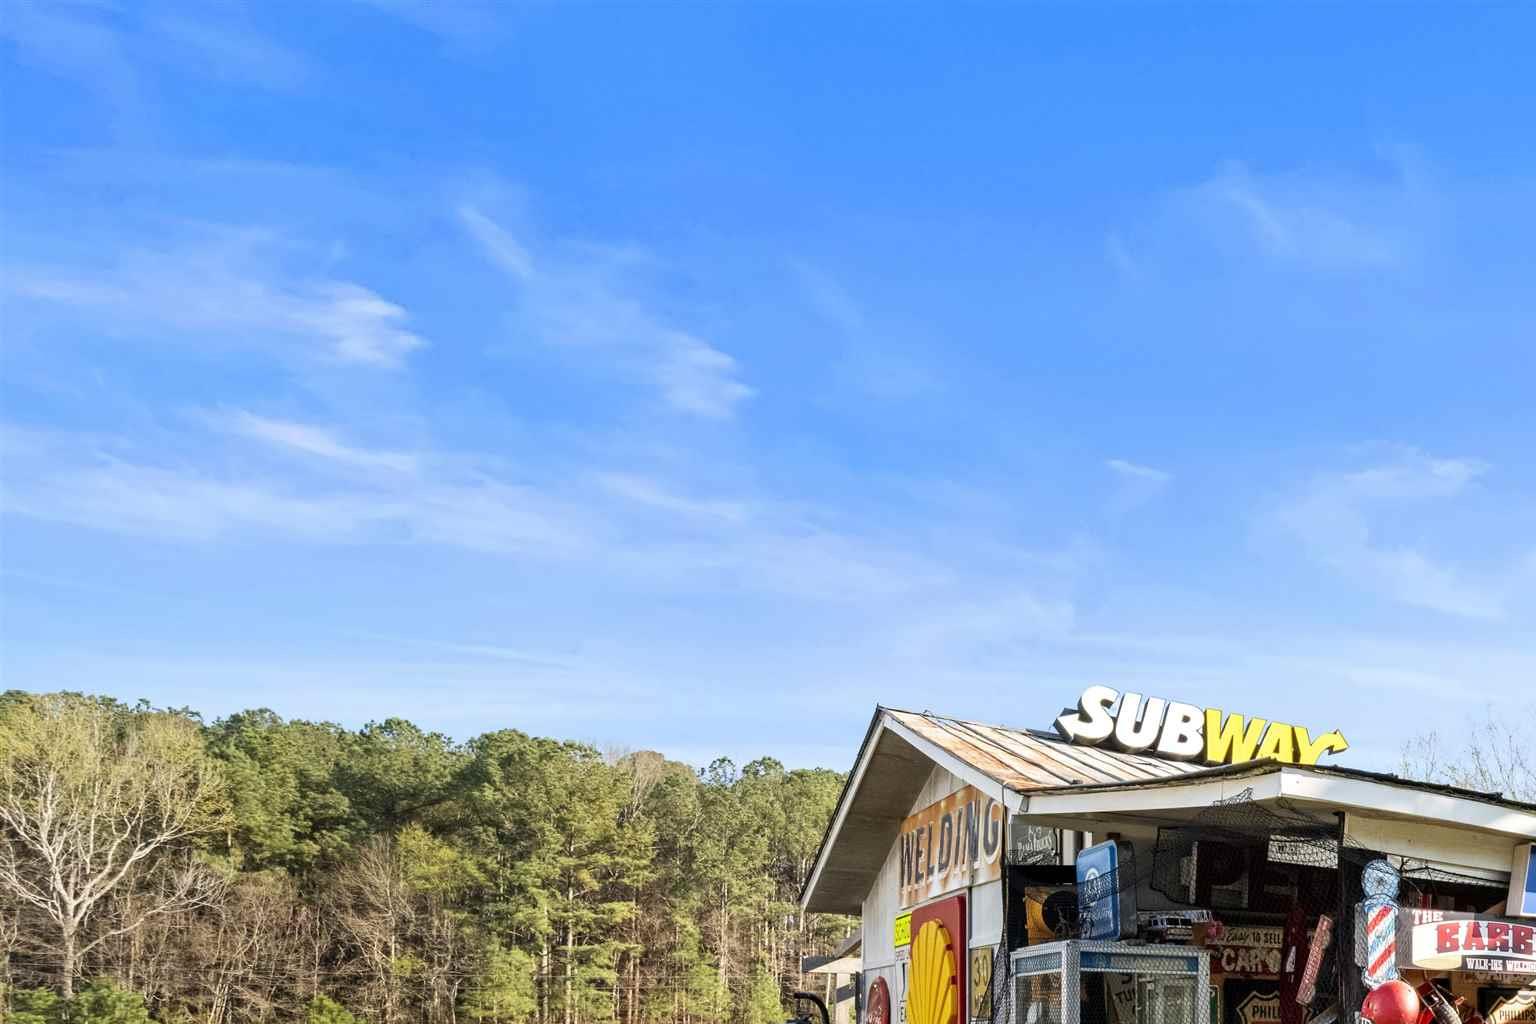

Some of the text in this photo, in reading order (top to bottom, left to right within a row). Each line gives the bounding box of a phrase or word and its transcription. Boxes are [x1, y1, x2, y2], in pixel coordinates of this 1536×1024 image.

[1055, 685, 1348, 765] SUBWAY
[900, 799, 1003, 890] WELDING
[1412, 909, 1444, 925] THE
[1500, 1008, 1536, 1021] PHILLIPS
